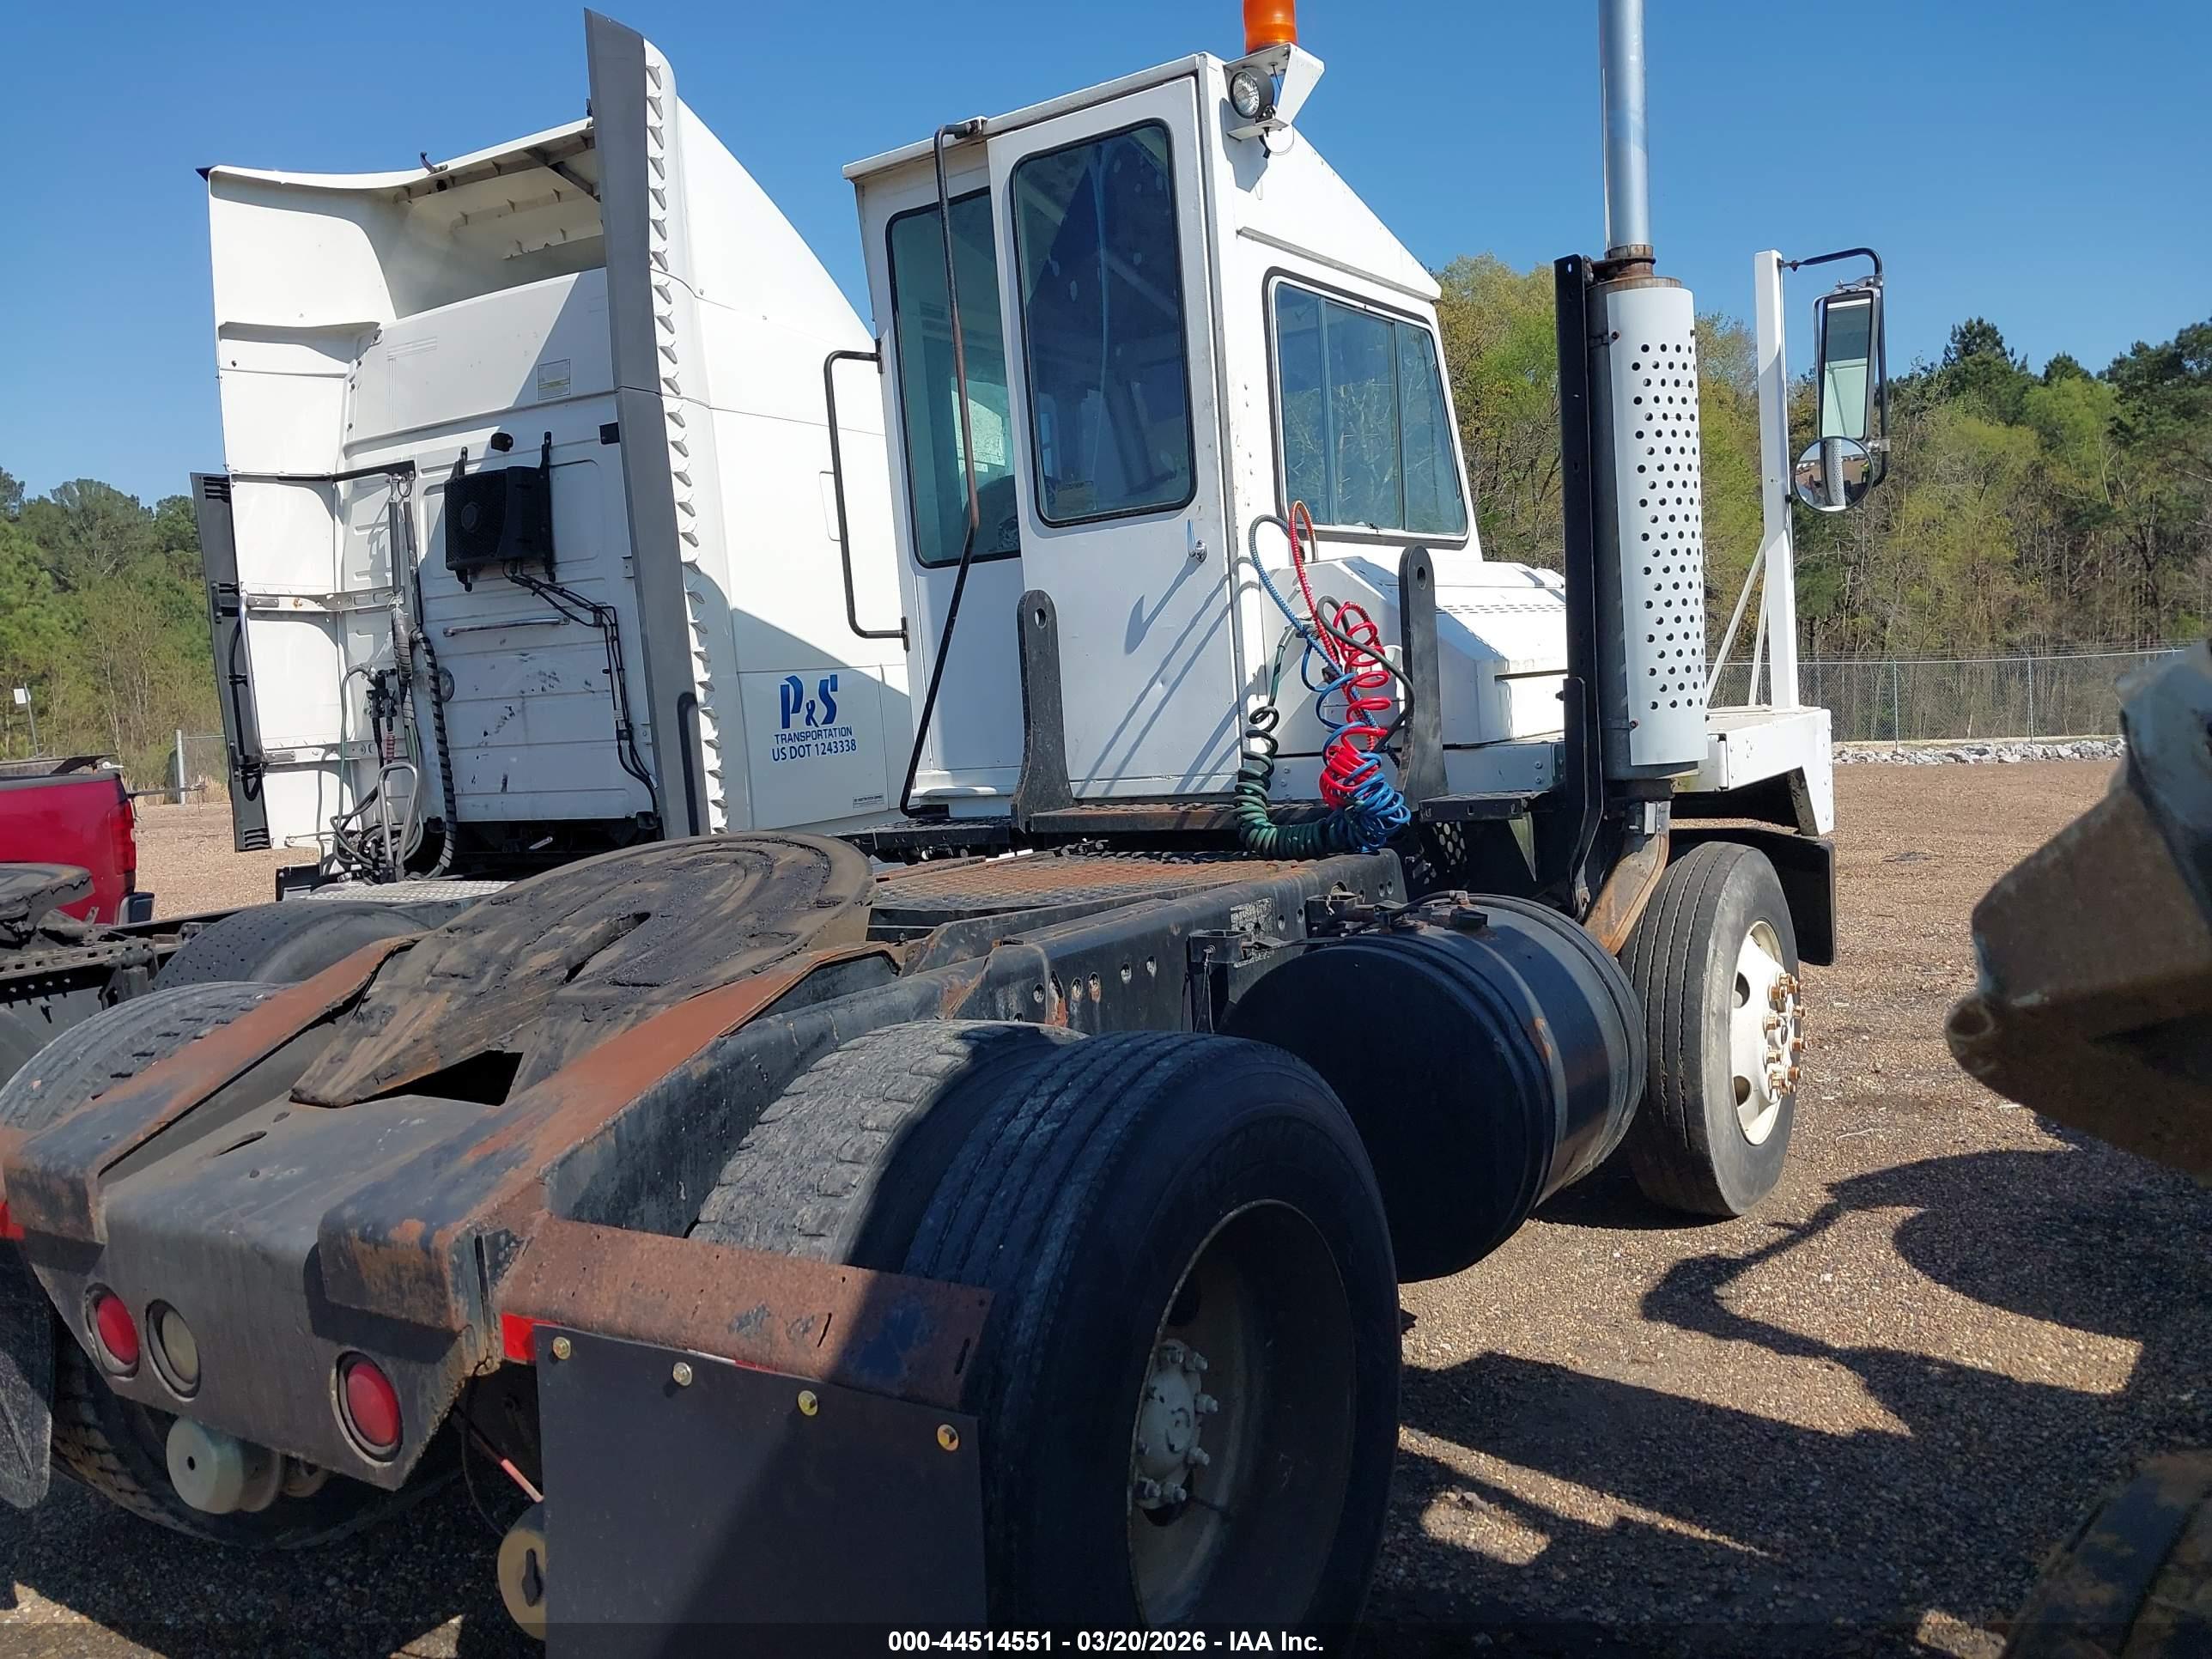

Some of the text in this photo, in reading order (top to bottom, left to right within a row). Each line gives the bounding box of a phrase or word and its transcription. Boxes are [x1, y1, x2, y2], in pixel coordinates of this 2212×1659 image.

[780, 674, 838, 729] P&S
[774, 726, 853, 744] TRANSPORTATION
[772, 738, 857, 762] US DOT 1243338
